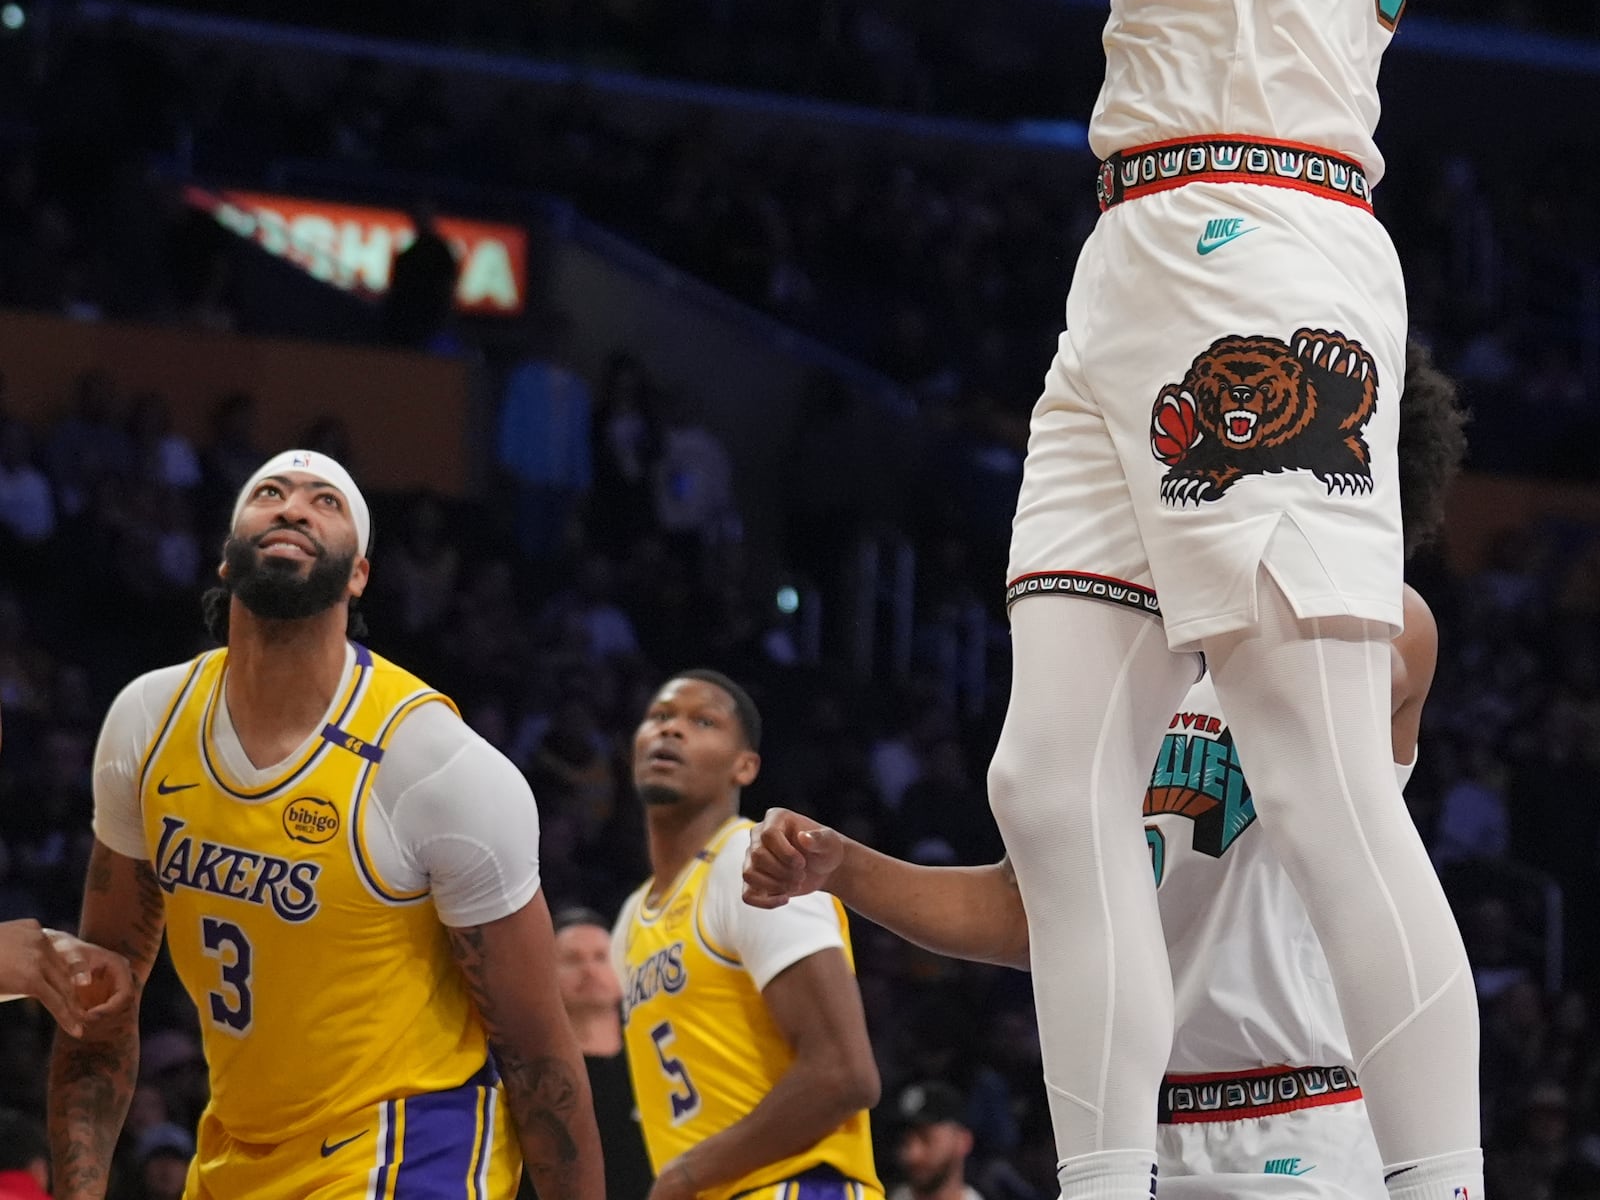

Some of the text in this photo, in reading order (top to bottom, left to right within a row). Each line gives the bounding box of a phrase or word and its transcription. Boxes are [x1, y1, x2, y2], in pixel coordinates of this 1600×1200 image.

[1203, 217, 1244, 241] NIKE
[289, 807, 336, 832] bibigo
[156, 816, 322, 923] LAKERS
[202, 916, 254, 1034] 3
[650, 1017, 702, 1126] 5
[1263, 1157, 1302, 1176] NIKE
